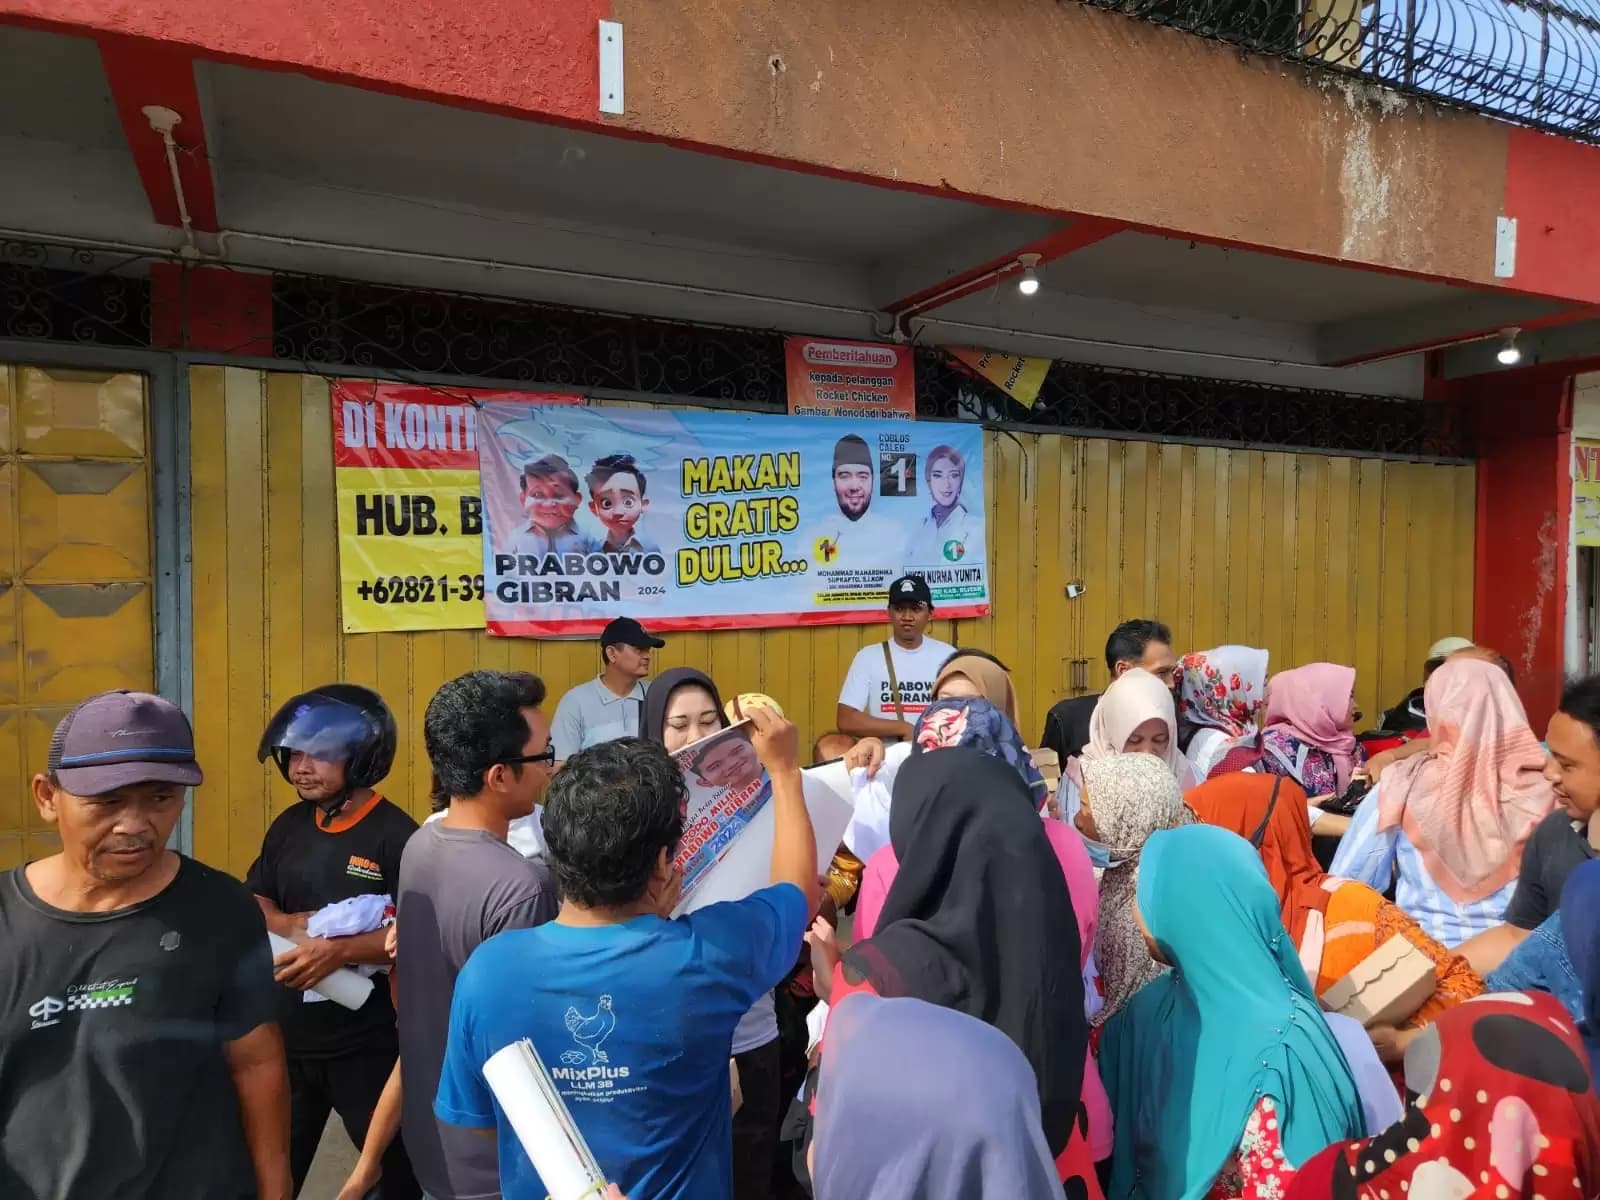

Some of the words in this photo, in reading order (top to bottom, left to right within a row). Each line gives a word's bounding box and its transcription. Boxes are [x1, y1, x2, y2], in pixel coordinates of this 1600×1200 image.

[808, 346, 892, 364] Pemberitahuan
[809, 371, 843, 383] kepada
[846, 375, 893, 387] pelanggan
[816, 389, 848, 400] Rocket
[852, 391, 888, 402] Chicken
[794, 405, 830, 416] Gambar
[835, 407, 878, 418] Wonodadi
[881, 408, 910, 419] bahwa
[343, 400, 377, 448] DI
[879, 434, 911, 443] COBLOS
[880, 443, 905, 452] CALEG
[682, 452, 800, 496] MAKAN
[356, 494, 448, 536] HUB.
[686, 496, 799, 541] GRATIS
[495, 554, 666, 576] PRABOWO
[677, 540, 808, 585] DULUR...
[817, 569, 854, 577] MOHAMMAD
[927, 570, 953, 583] NURMA
[954, 568, 981, 582] YUNITA
[357, 575, 485, 605] +62821-39
[496, 581, 621, 603] GIBRAN
[638, 586, 666, 595] 2024
[724, 778, 762, 817] GIBRAN
[551, 1066, 630, 1080] MixPlus
[570, 1081, 595, 1089] LLM
[597, 1080, 614, 1088] 3B
